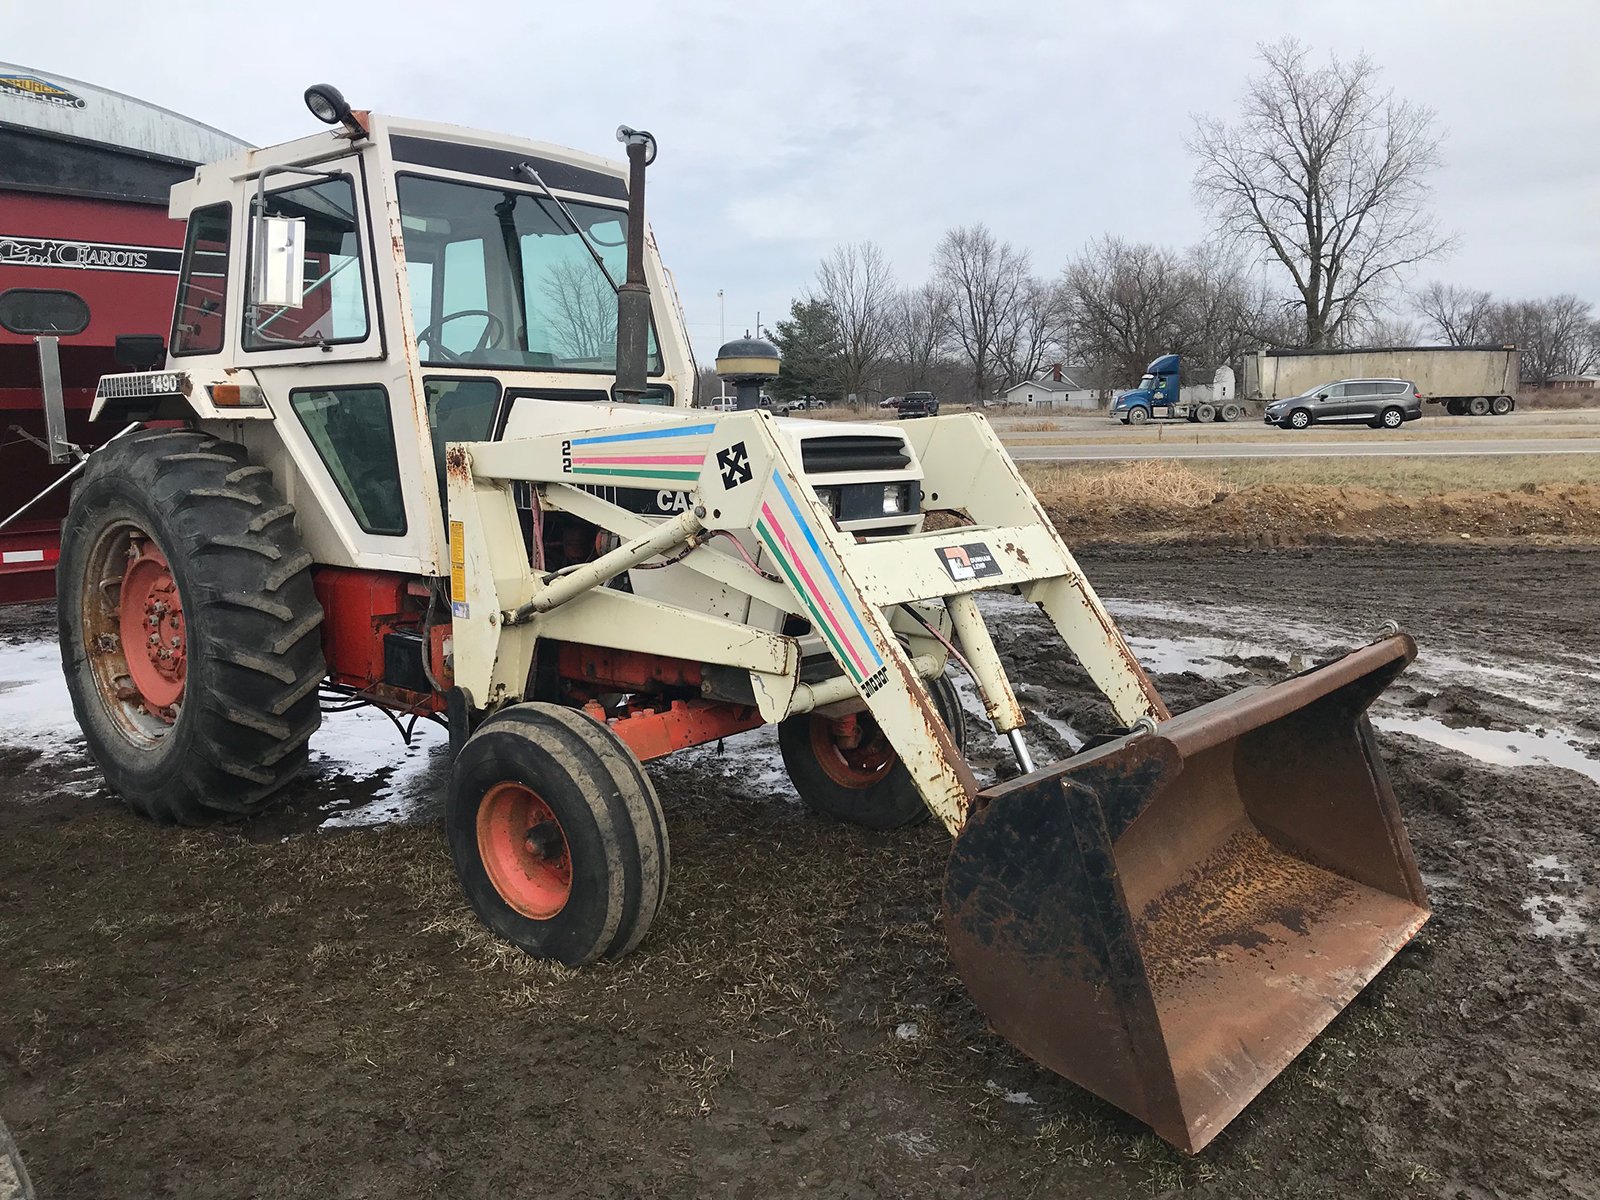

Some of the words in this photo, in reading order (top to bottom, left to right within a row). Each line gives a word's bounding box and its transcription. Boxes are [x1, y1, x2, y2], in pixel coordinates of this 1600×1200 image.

[0, 85, 74, 108] HUR-LOK
[56, 242, 148, 269] CHARIOTS
[151, 374, 177, 392] 1490
